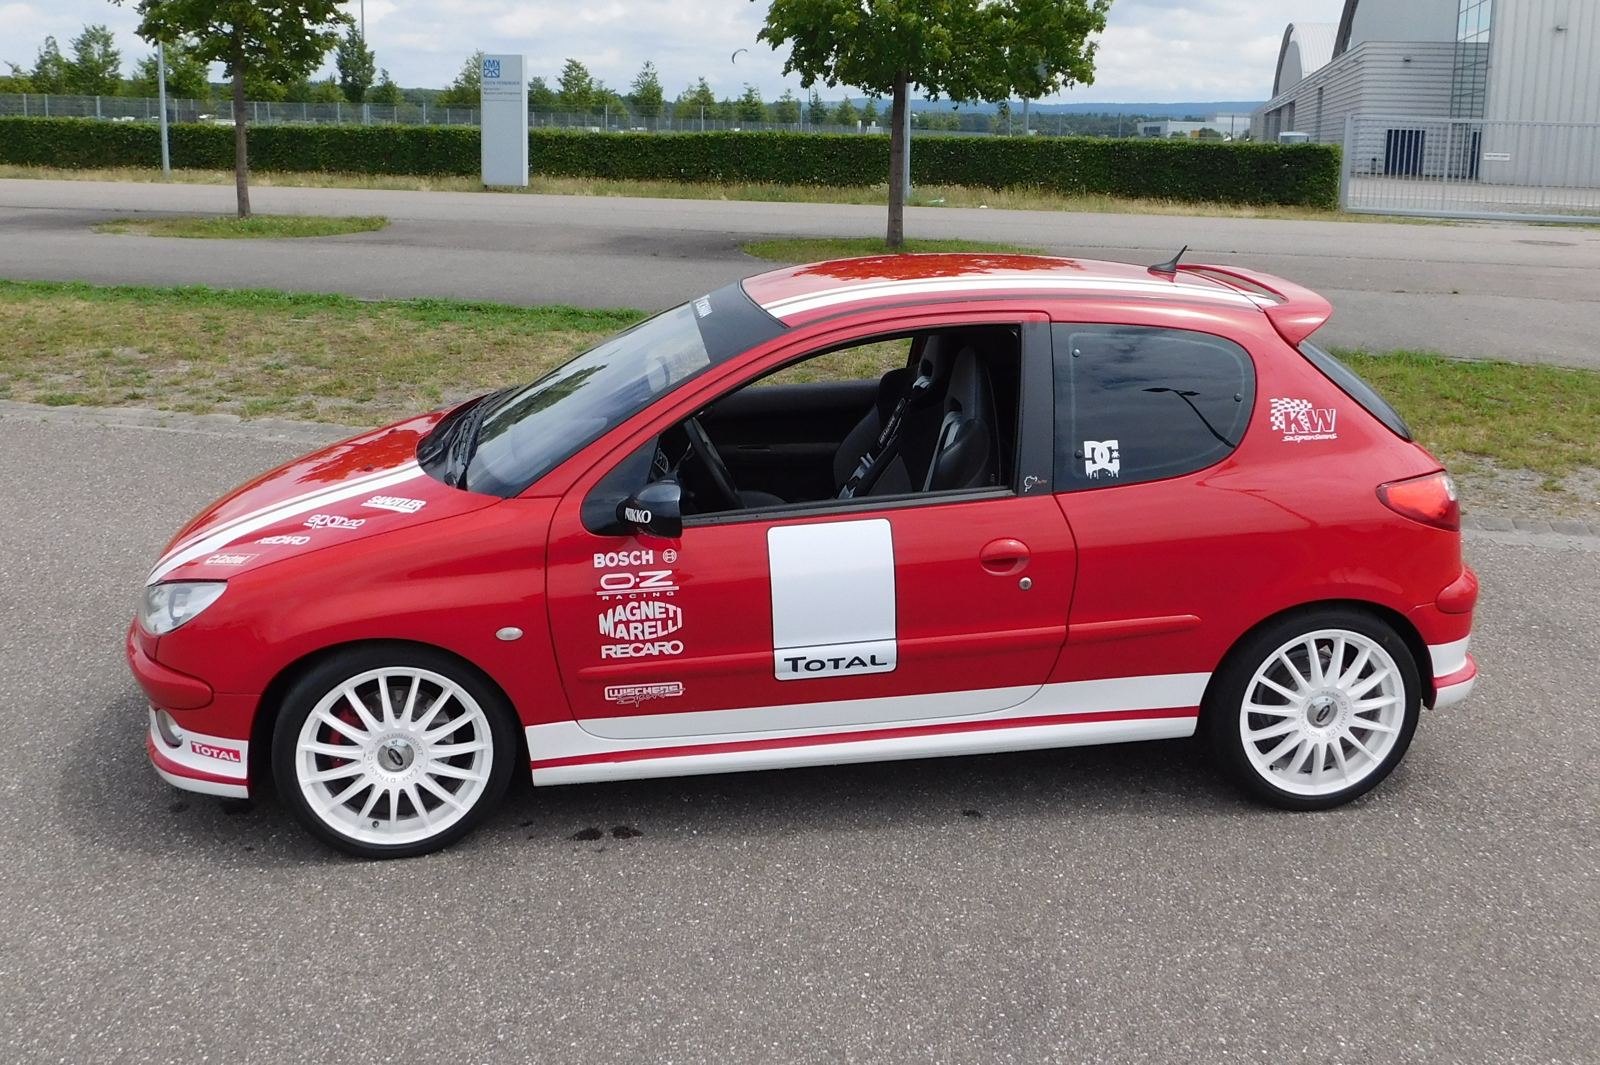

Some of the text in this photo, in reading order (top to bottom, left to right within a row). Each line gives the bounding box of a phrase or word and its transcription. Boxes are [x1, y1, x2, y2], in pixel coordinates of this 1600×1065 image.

[1283, 408, 1336, 434] KW
[305, 514, 366, 529] sparco
[624, 507, 652, 524] NIKKO
[593, 550, 654, 568] BOSCH
[602, 591, 675, 601] RACING
[598, 601, 683, 628] MAGNETI
[598, 615, 683, 641] MARELLI
[601, 640, 684, 659] RECARO
[783, 654, 888, 673] TOTAL
[192, 742, 240, 762] TOTAL
